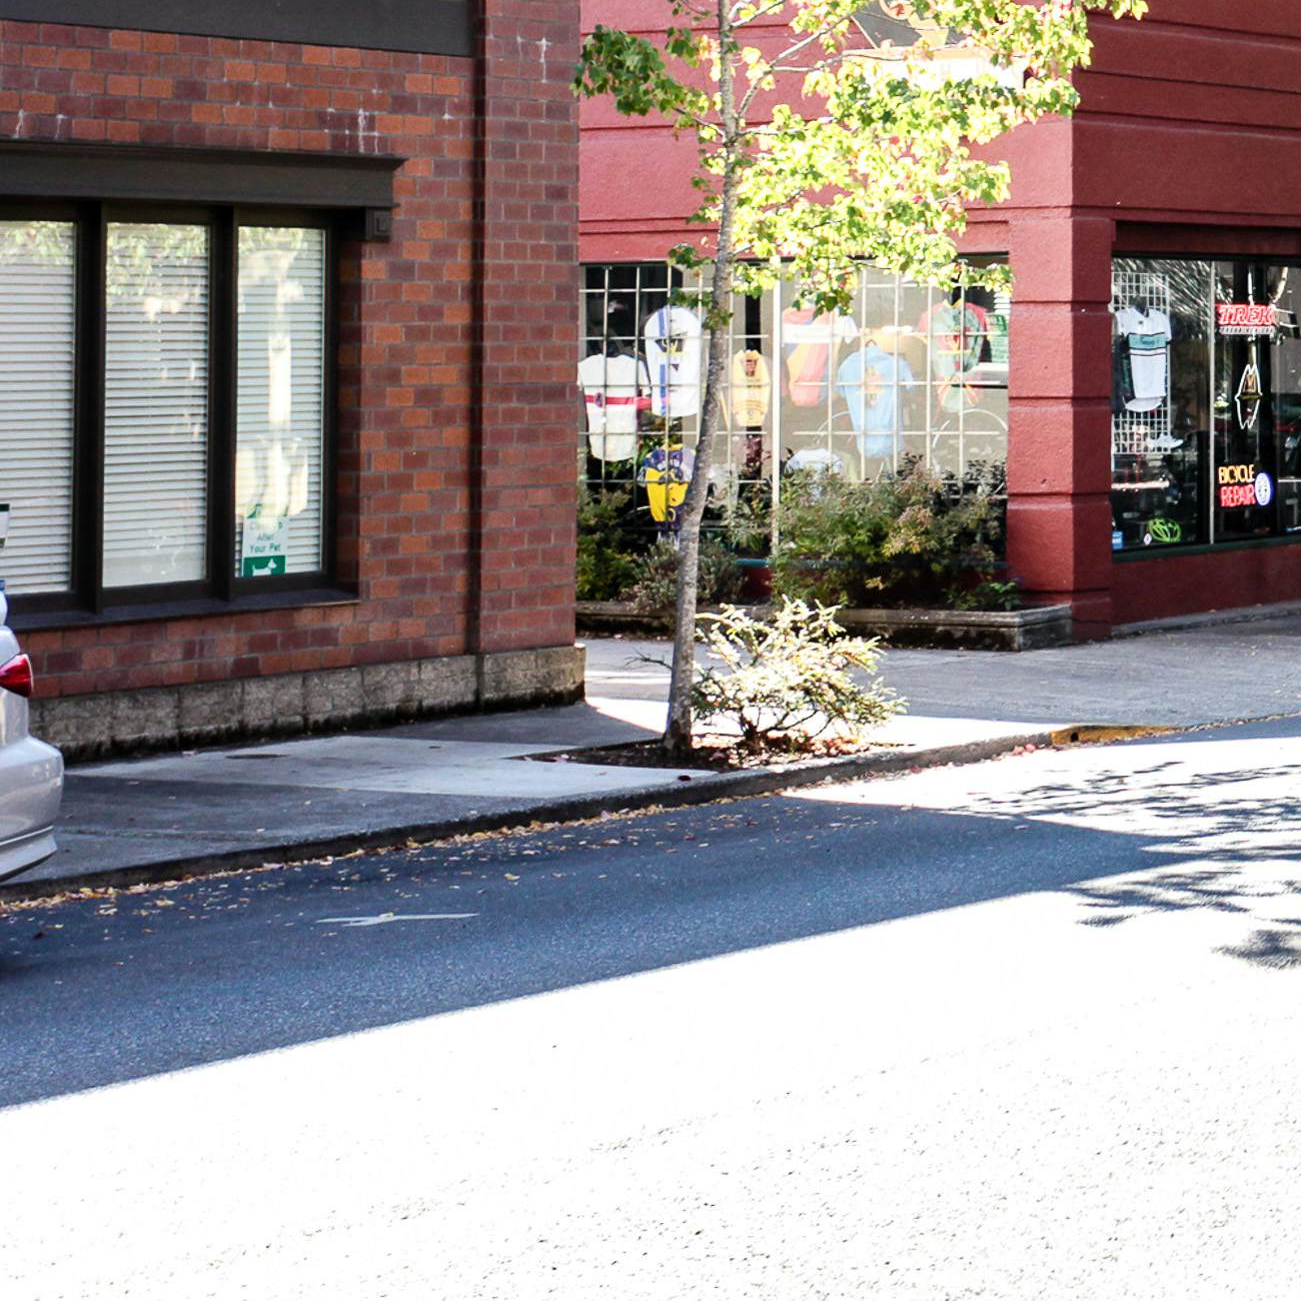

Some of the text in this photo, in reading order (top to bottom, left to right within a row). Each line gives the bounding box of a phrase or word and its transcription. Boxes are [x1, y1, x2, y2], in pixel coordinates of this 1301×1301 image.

[1218, 305, 1274, 326] TREK
[1218, 464, 1255, 484] BICYCLE
[1220, 484, 1256, 507] REPAIR
